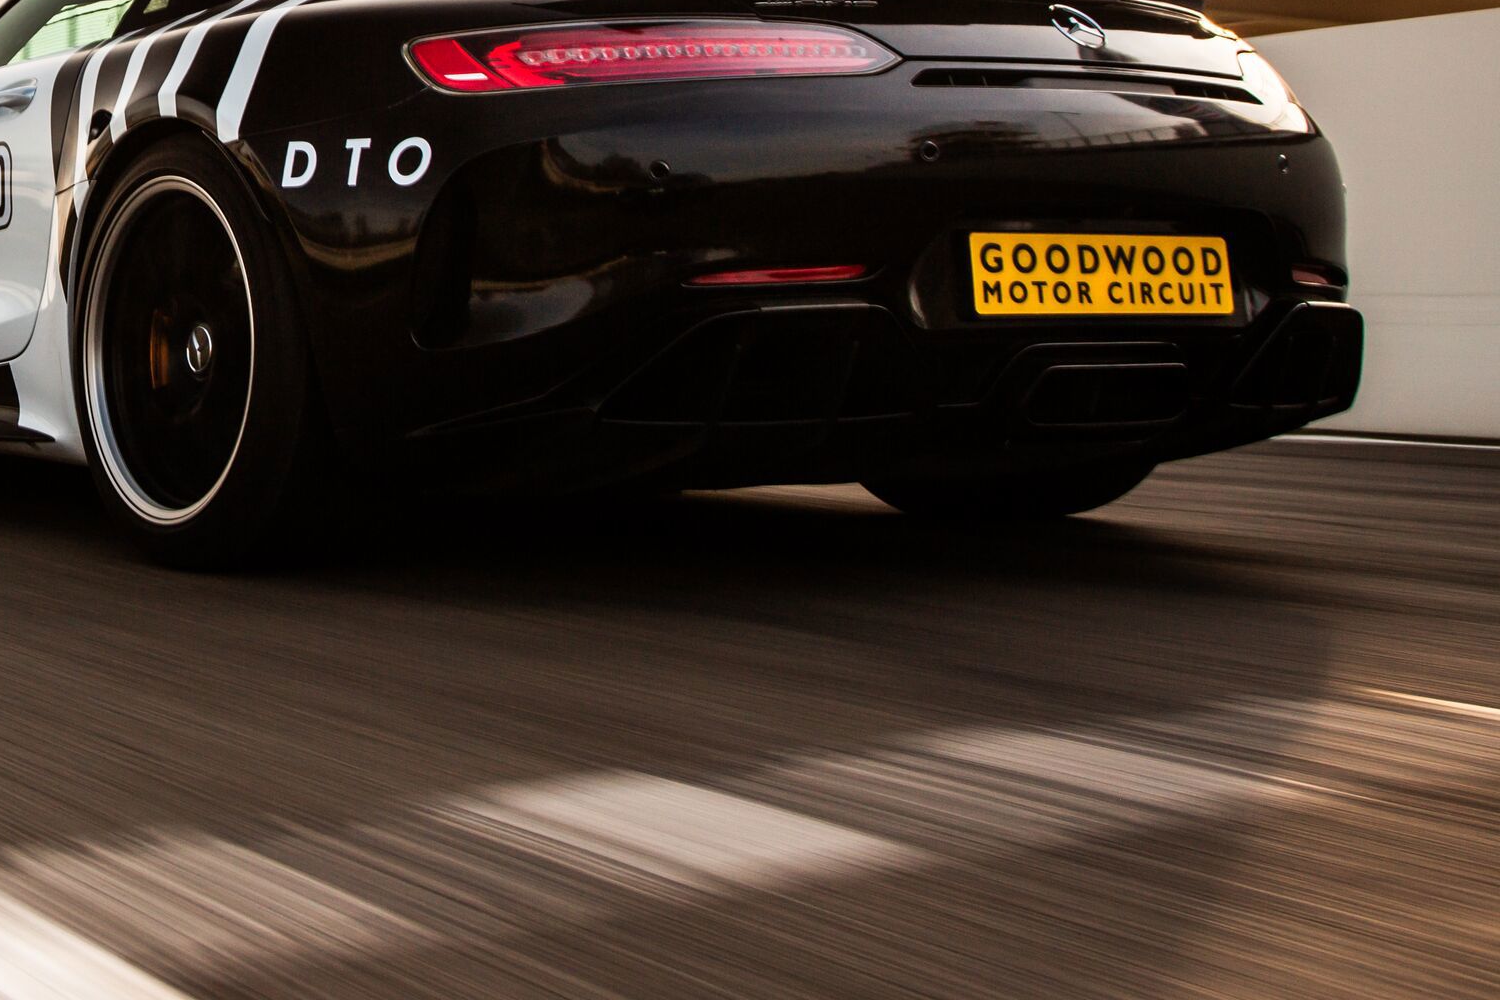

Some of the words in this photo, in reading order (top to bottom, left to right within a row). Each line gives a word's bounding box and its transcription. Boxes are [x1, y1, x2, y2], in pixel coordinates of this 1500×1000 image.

[281, 136, 433, 188] DTO
[979, 242, 1223, 276] GOODWOOD
[982, 280, 1093, 305] MOTOR
[1107, 281, 1224, 305] CIRCUIT
